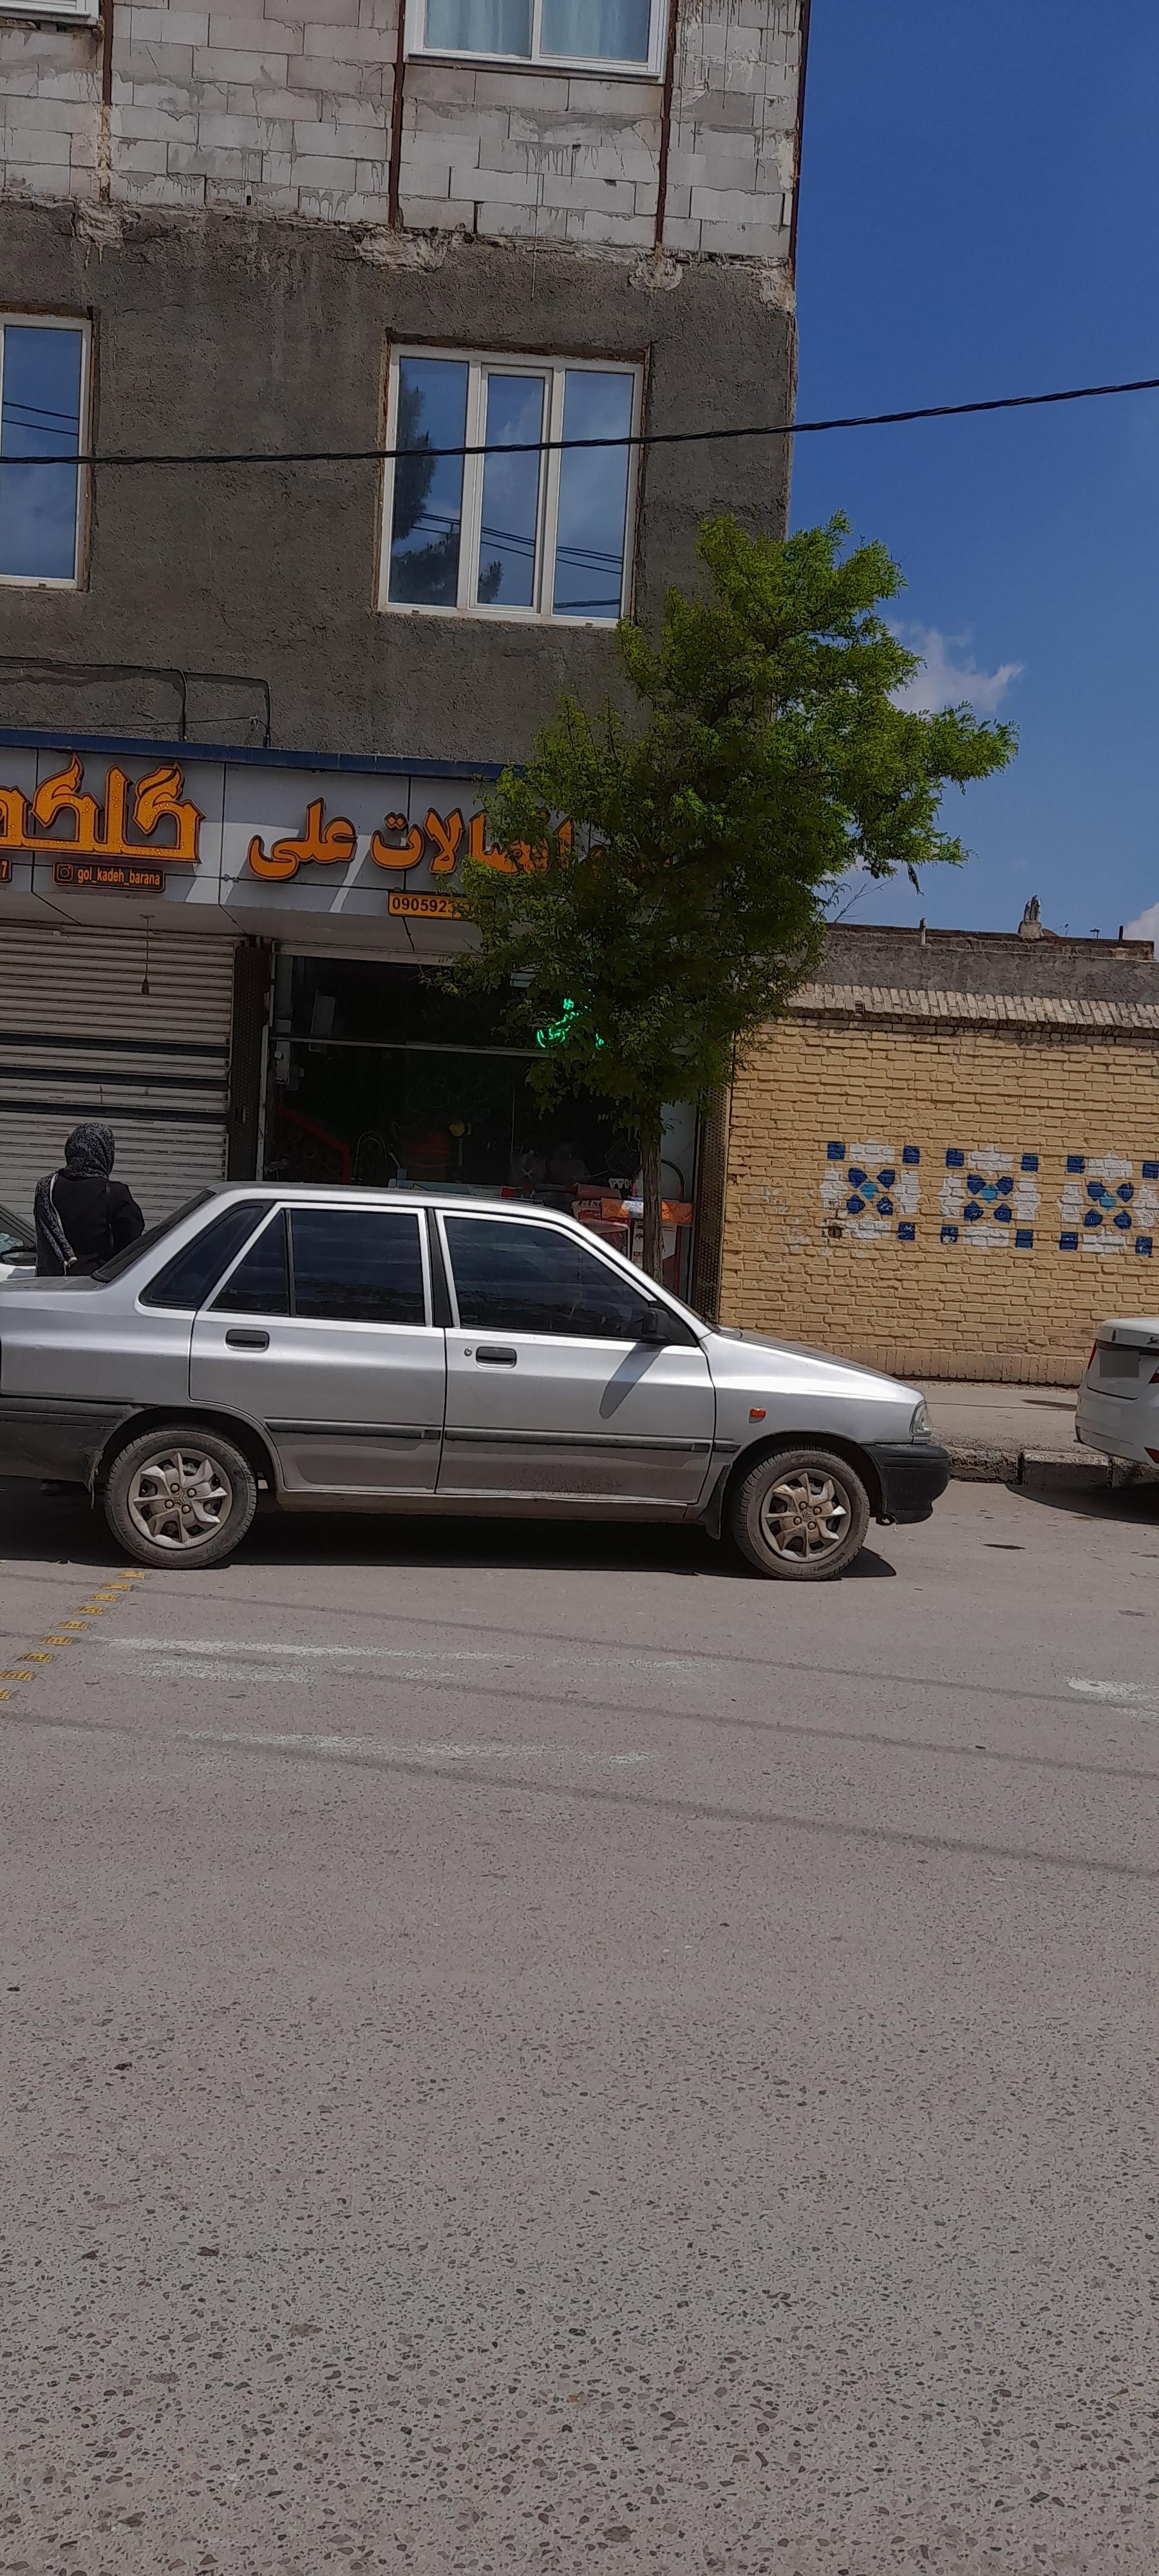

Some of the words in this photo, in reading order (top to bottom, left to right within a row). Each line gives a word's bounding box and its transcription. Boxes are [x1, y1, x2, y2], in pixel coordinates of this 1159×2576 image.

[248, 798, 357, 881] علی
[77, 866, 161, 886] gol_kadeh_barana
[392, 896, 491, 919] 090592
